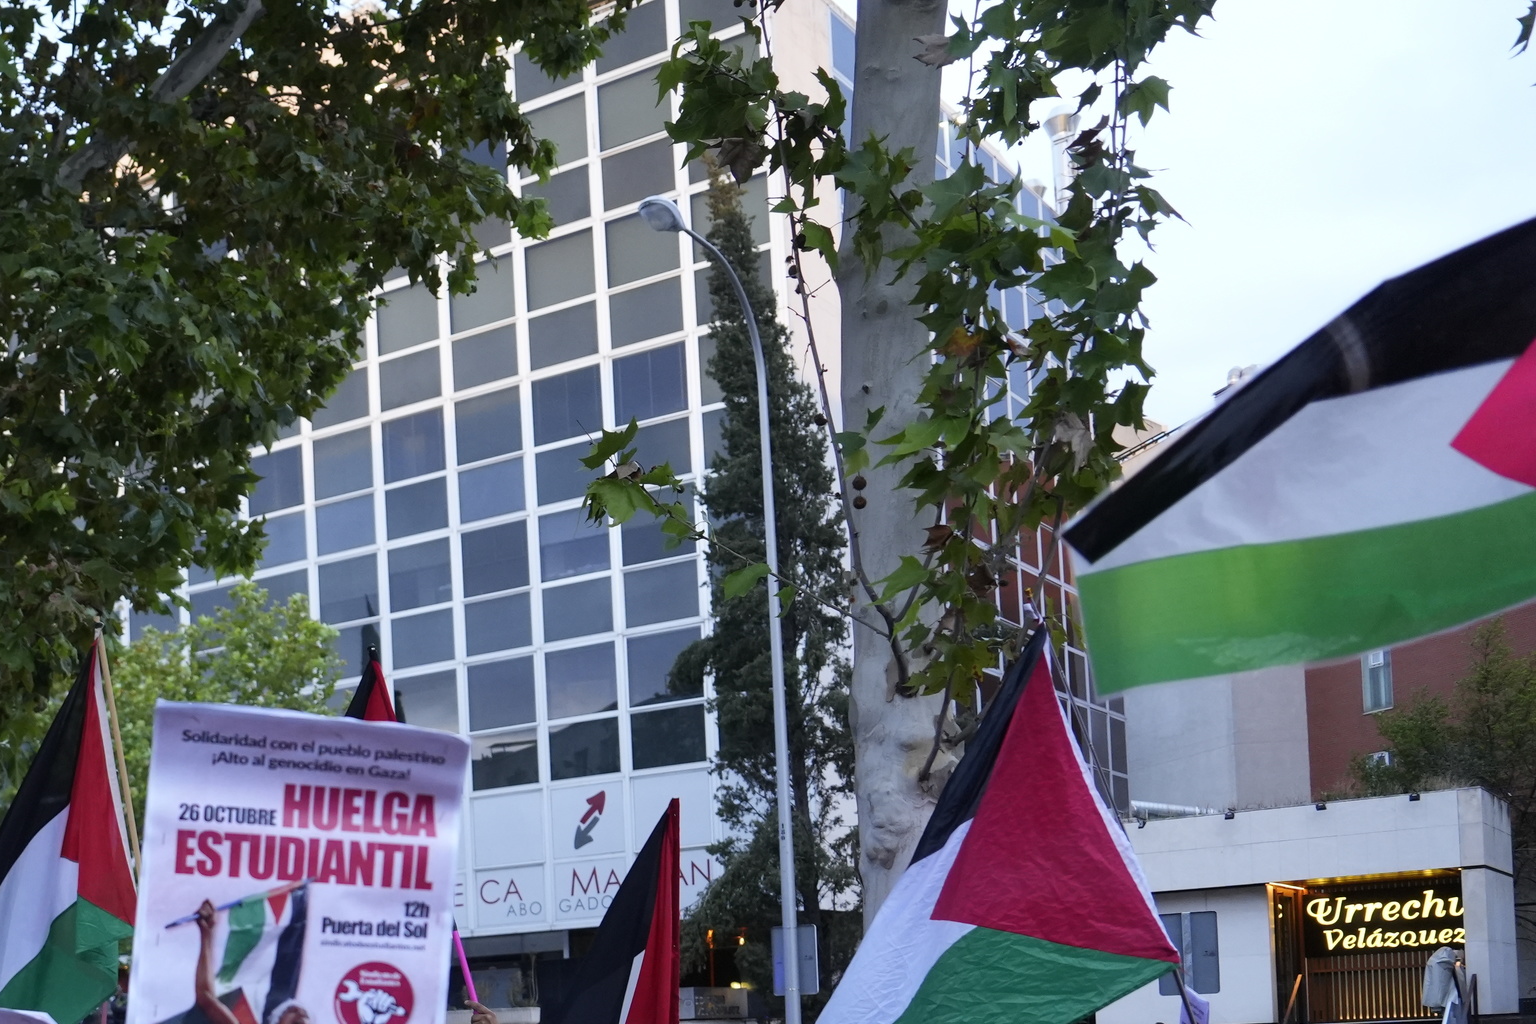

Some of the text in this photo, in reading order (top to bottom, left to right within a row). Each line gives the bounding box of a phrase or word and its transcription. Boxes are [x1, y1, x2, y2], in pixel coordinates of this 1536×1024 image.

[182, 729, 446, 767] Solidaridad con el pueblo palestino
[212, 751, 412, 781] ¡Alto al genocidio en Gaza!
[179, 783, 438, 837] 26 OCTUBRE HUELGA
[174, 829, 434, 890] ESTUDIANTIL
[405, 901, 430, 918] 12h
[322, 917, 428, 939] Puerta del Sol
